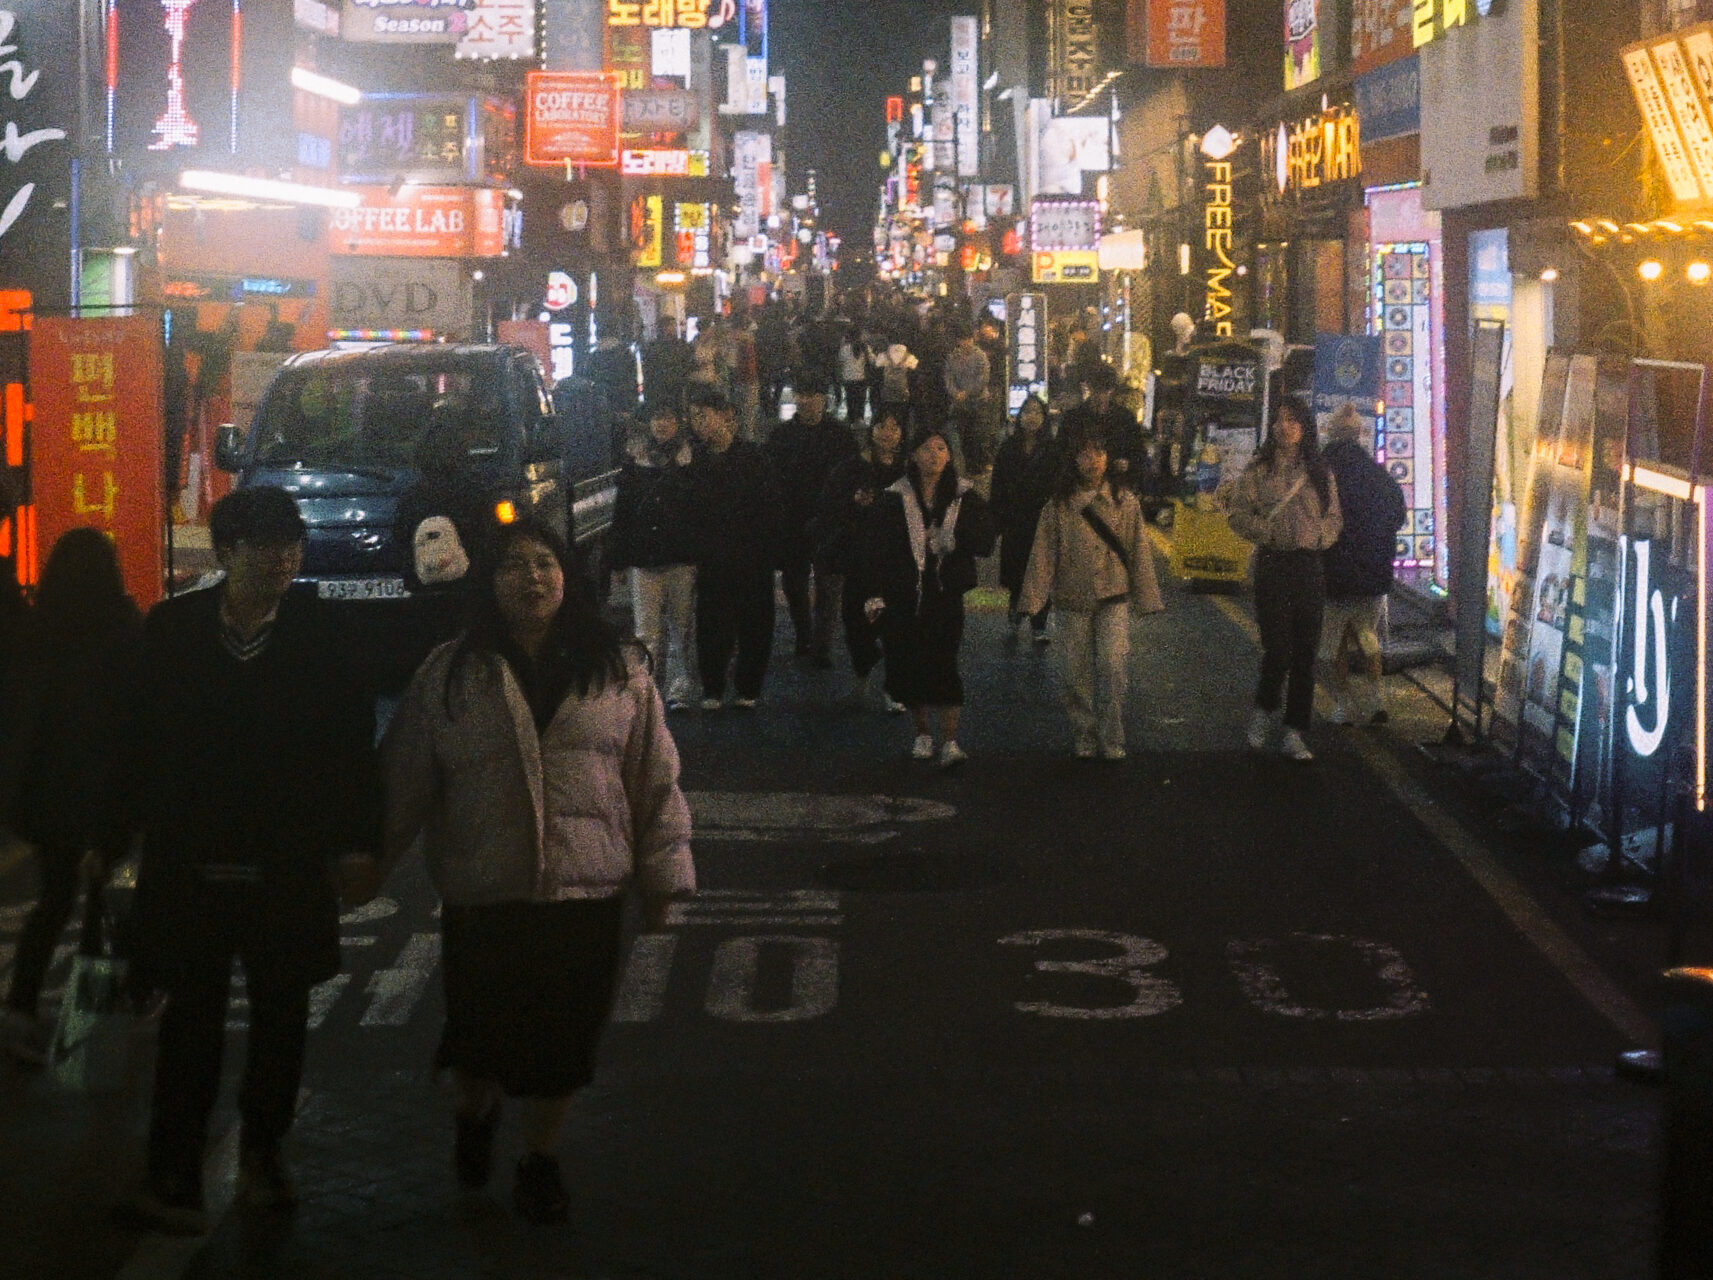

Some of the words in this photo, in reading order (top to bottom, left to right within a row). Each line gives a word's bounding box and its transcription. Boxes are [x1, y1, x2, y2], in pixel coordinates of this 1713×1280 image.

[374, 14, 445, 33] Season
[467, 19, 526, 44] 소주
[534, 91, 609, 111] COFFEE
[1205, 162, 1233, 252] FREE
[414, 207, 465, 233] LAB
[1199, 363, 1256, 380] BLACK
[1196, 378, 1256, 395] FRIDAY
[996, 928, 1434, 1022] 30
